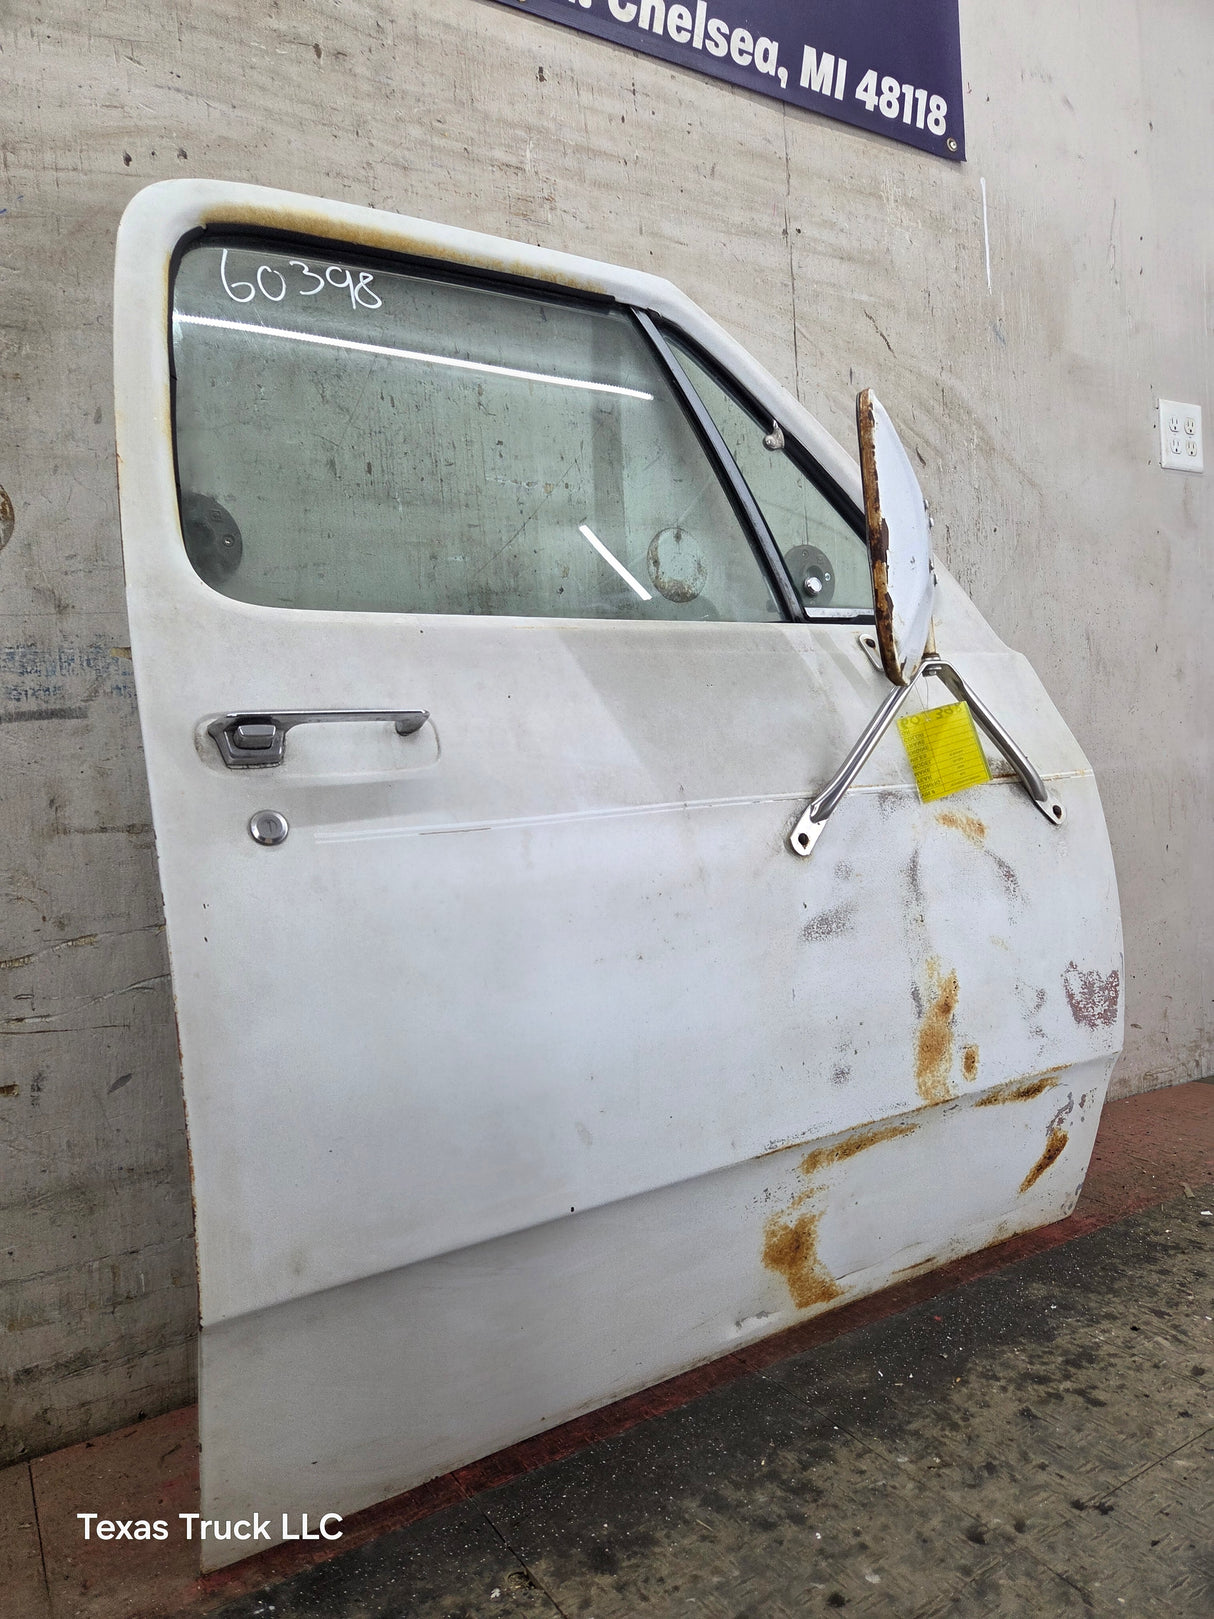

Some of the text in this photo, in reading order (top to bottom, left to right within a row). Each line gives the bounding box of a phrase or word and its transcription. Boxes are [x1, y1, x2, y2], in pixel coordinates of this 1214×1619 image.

[800, 44, 848, 101] MI
[855, 69, 949, 136] 48118
[220, 248, 383, 310] 60398
